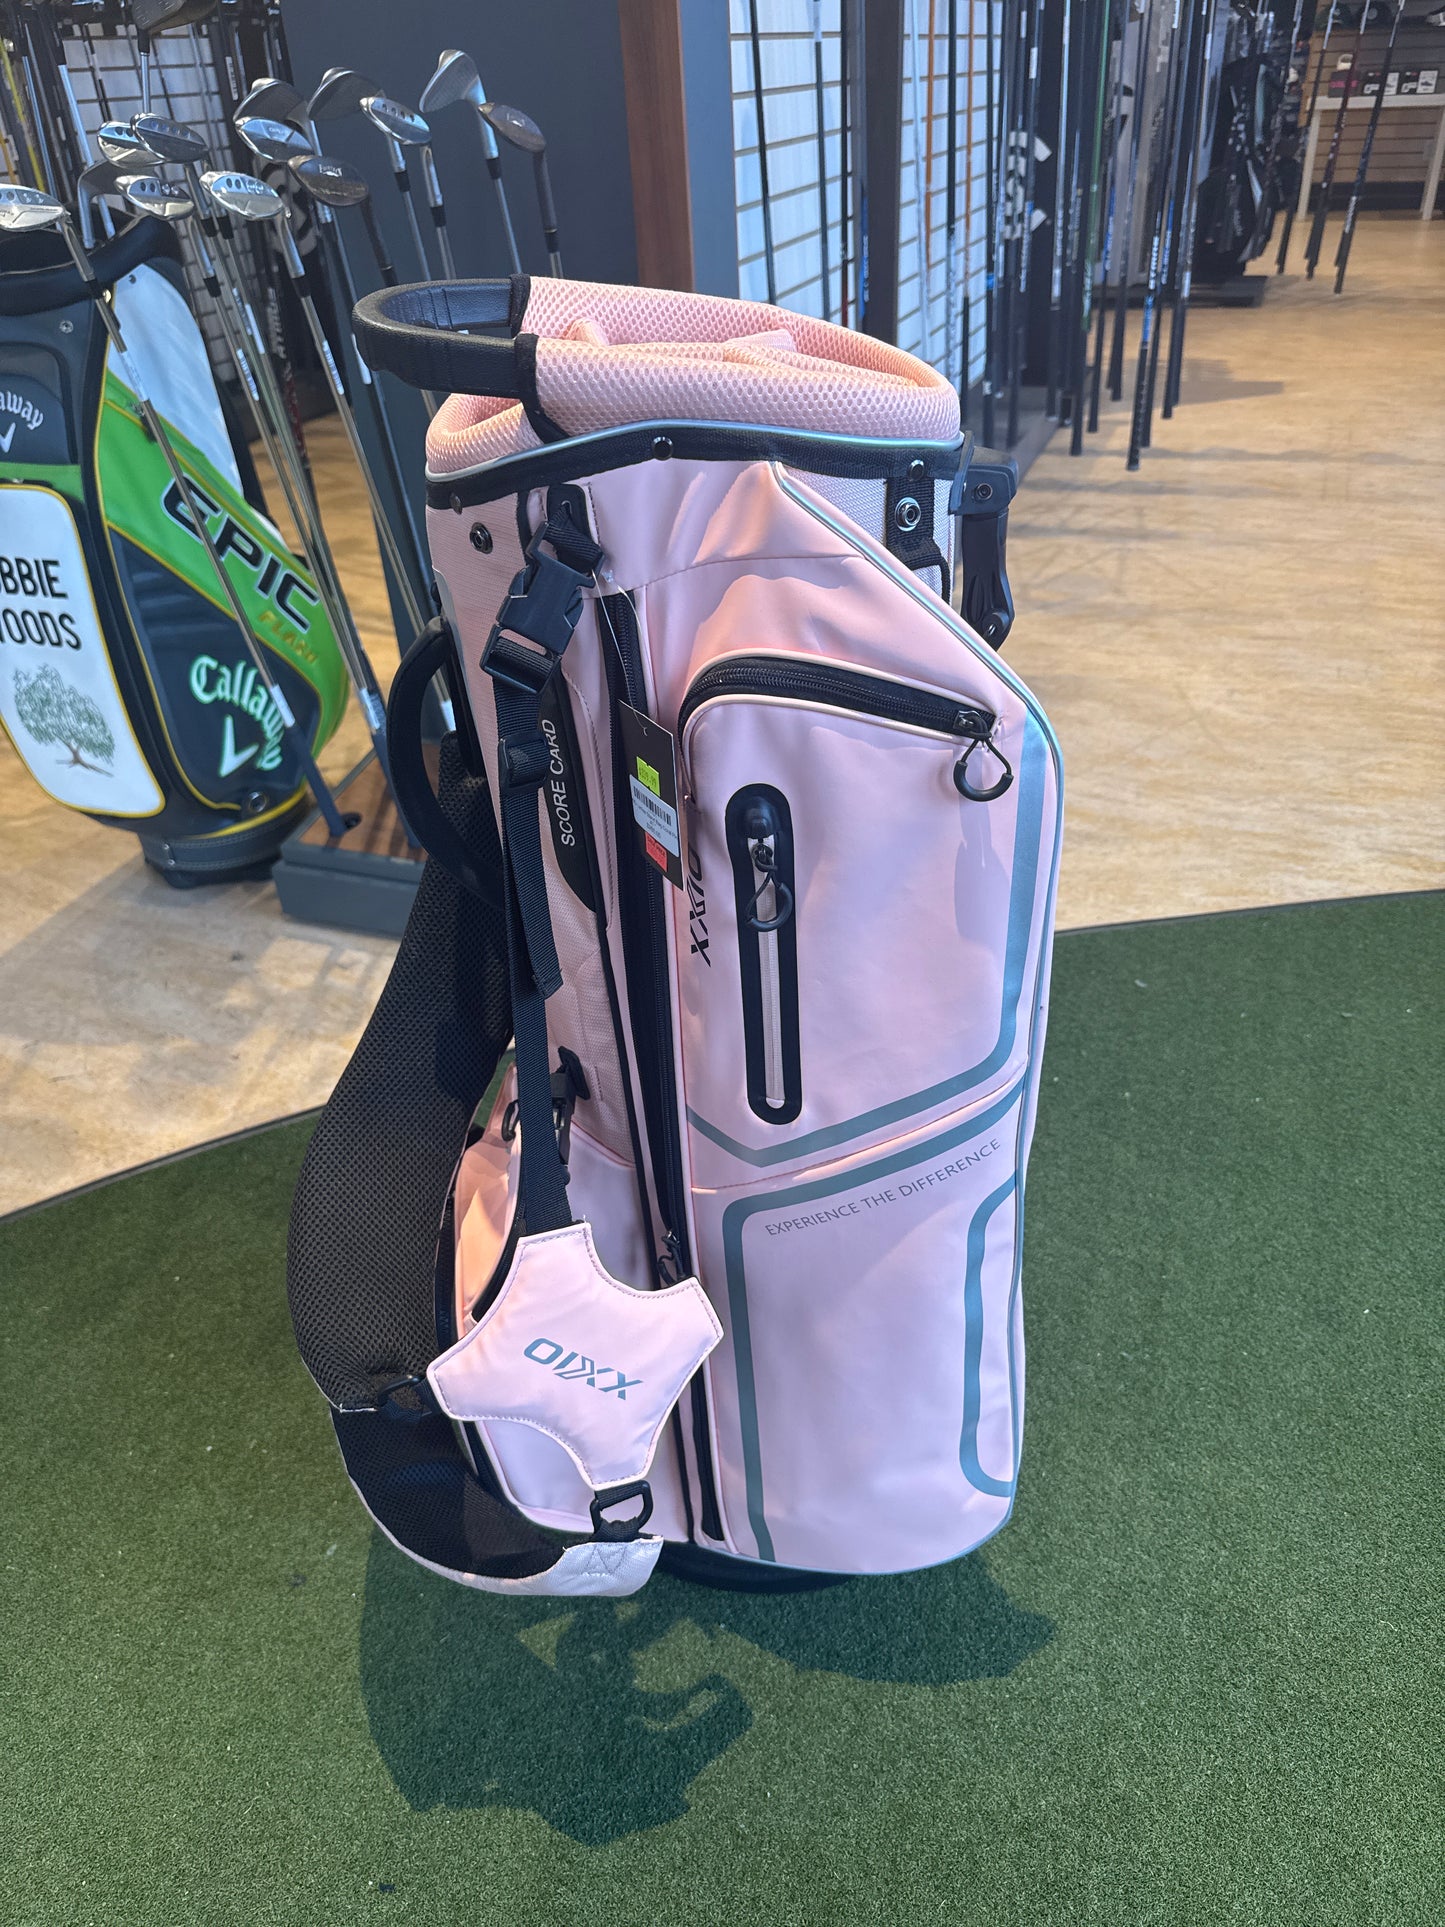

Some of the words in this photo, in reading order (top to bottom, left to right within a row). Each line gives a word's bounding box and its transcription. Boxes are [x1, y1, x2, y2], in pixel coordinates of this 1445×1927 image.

[0, 555, 68, 599] BBIE
[161, 473, 320, 634] EPIC
[0, 608, 82, 651] OODS
[541, 719, 564, 775] CARD
[551, 780, 576, 847] SCORE
[687, 843, 711, 967] XXIO
[764, 1201, 861, 1237] EXPERIENCE
[860, 1188, 898, 1210] THE
[898, 1138, 1001, 1198] DIFFERENCE
[523, 1337, 643, 1400] XXIO
